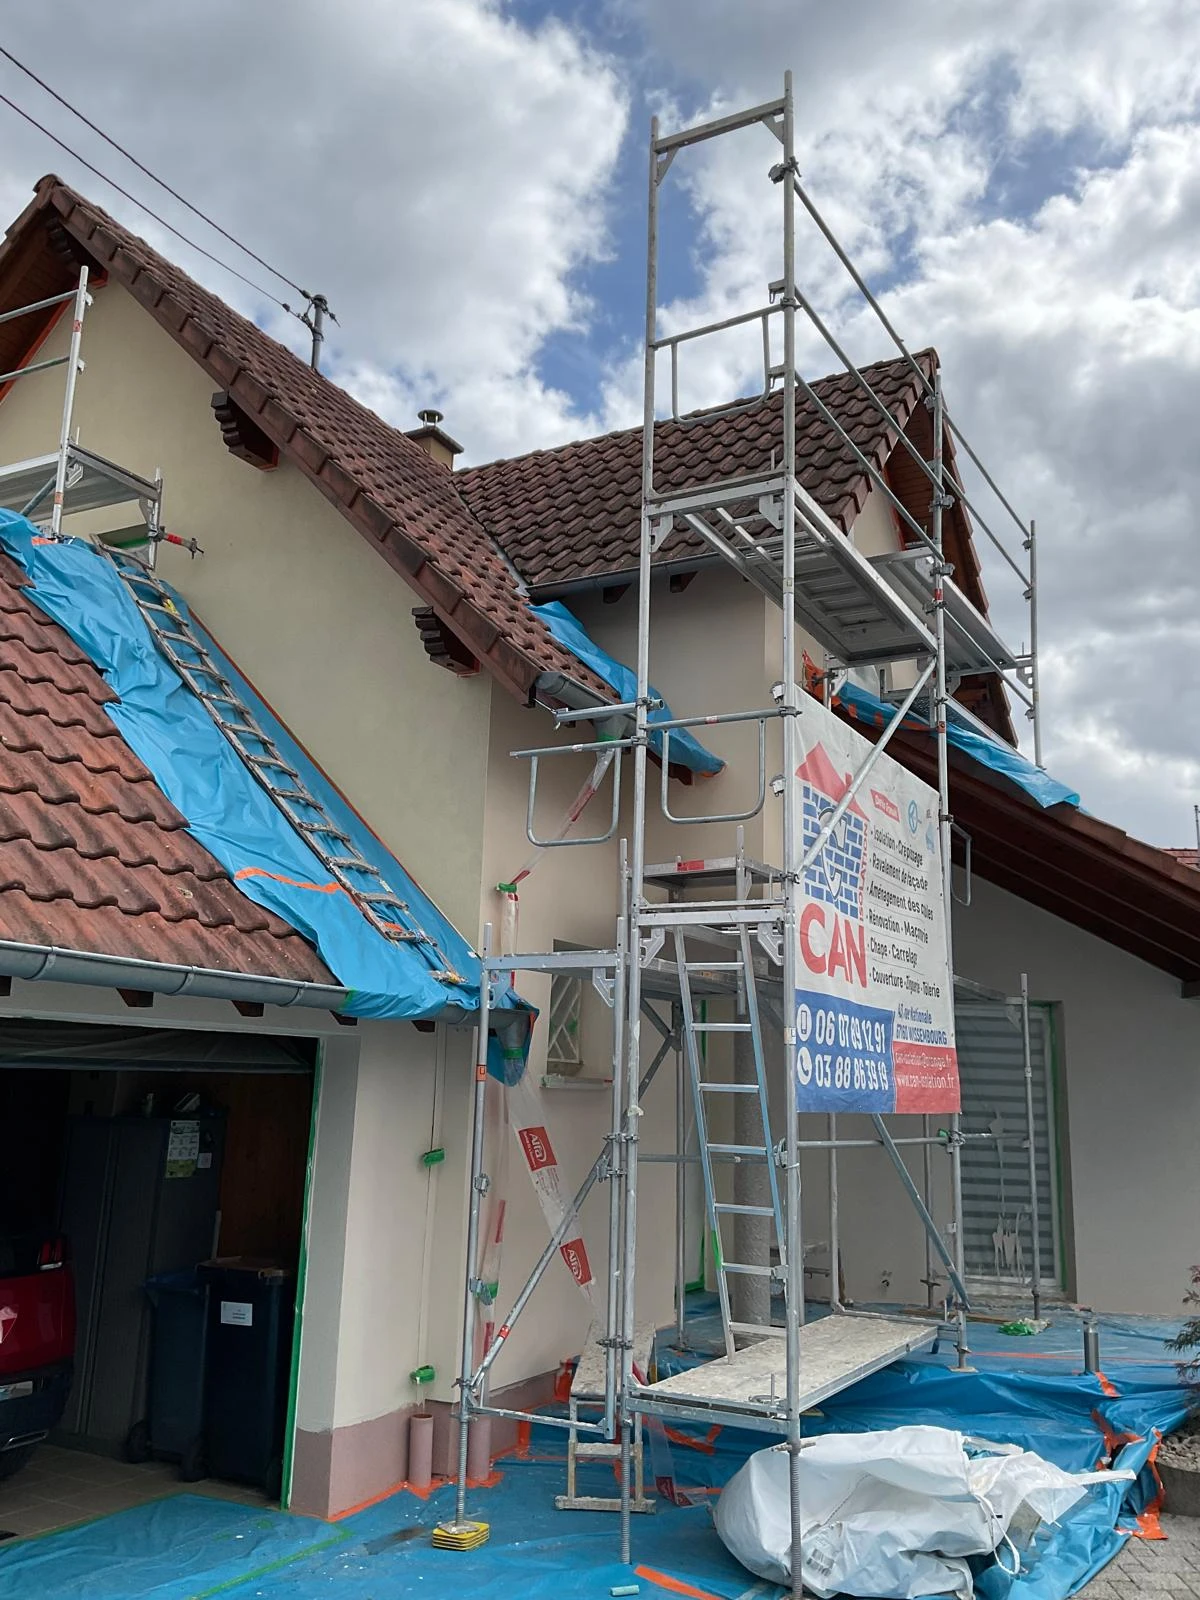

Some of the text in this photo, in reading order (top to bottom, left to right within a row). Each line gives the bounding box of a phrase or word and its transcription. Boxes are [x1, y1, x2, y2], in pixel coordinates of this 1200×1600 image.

[872, 852, 901, 881] Ravalement
[907, 897, 921, 914] des
[868, 908, 928, 944] Rénovation Maçrie
[800, 903, 868, 988] CAN
[870, 937, 888, 959] Chape
[872, 966, 904, 988] Couverture
[815, 1009, 835, 1046] 06
[838, 1013, 850, 1048] 07
[862, 1019, 875, 1052] 12
[874, 1021, 886, 1054] 91
[908, 1027, 948, 1046] WISSEMBOURG
[814, 1053, 889, 1091] 03 88 86 39 19
